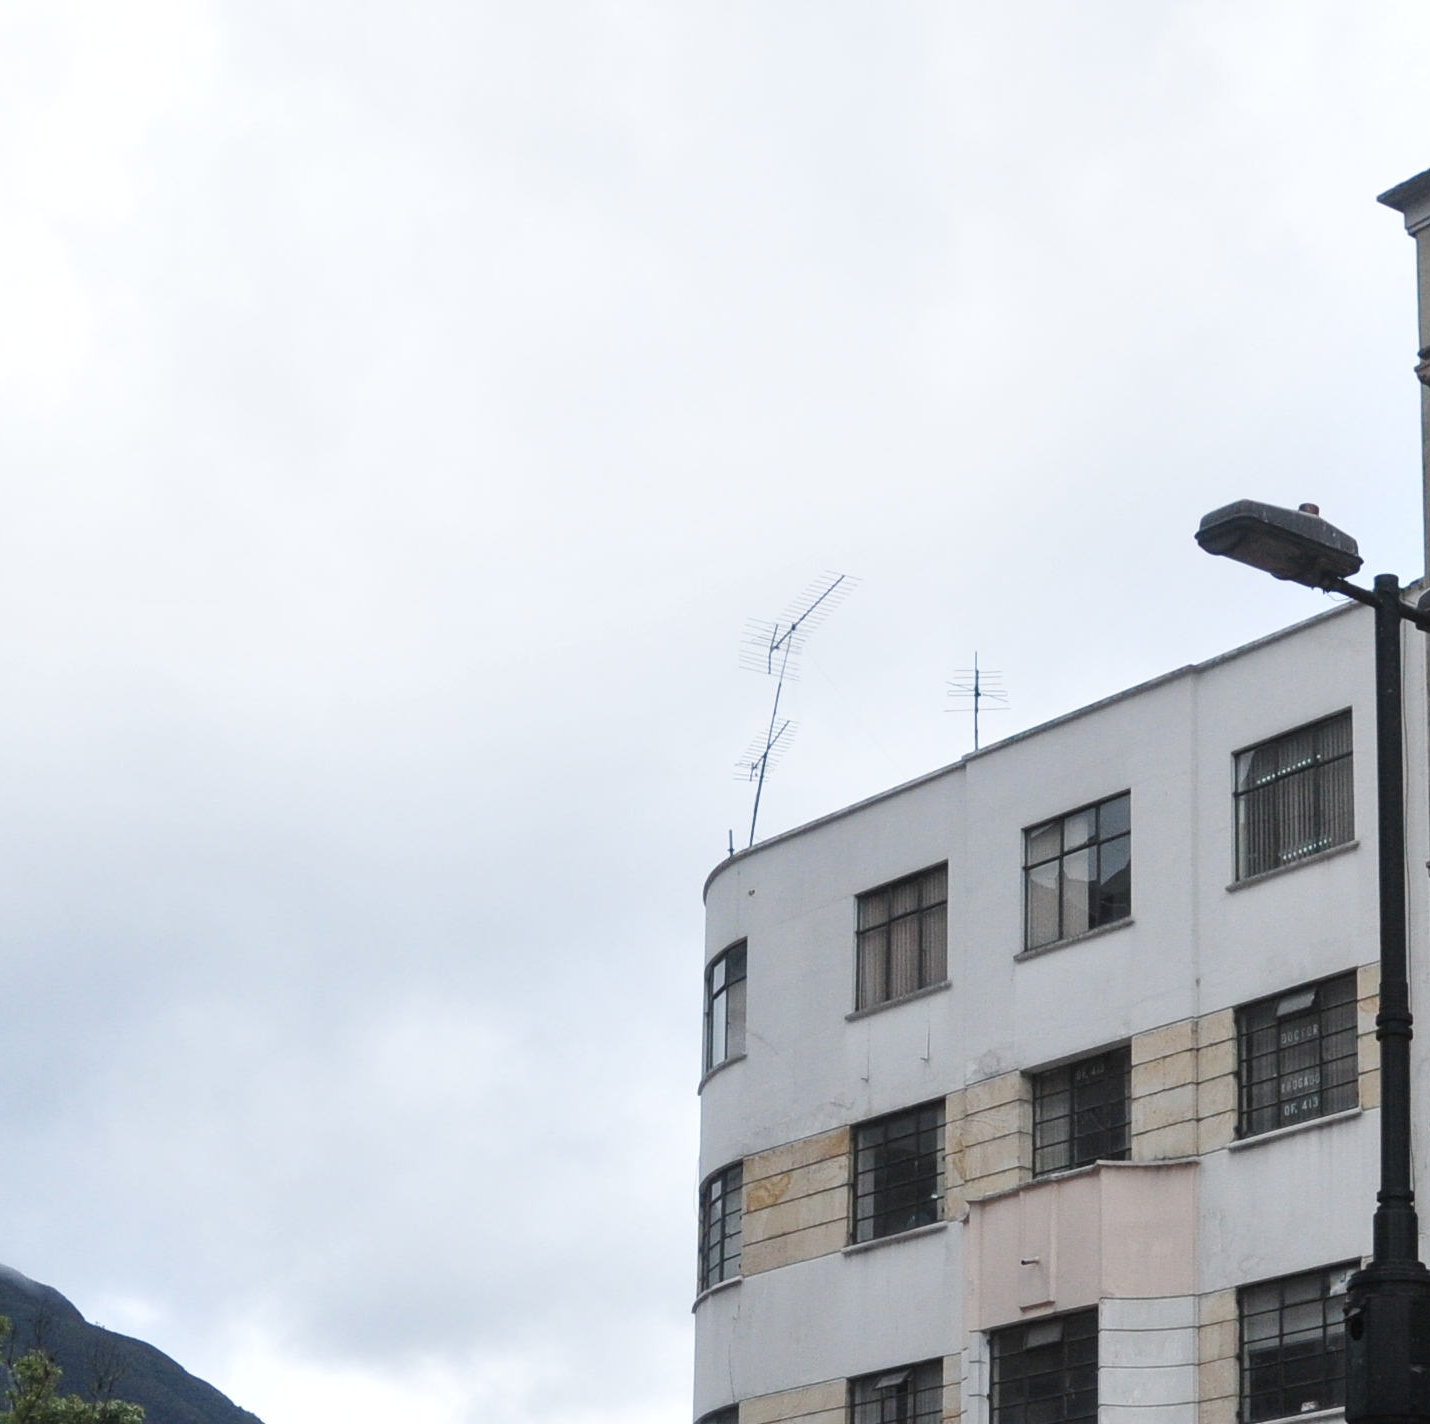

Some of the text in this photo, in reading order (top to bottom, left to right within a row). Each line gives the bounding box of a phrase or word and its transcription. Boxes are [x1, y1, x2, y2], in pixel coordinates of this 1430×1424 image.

[1281, 1023, 1319, 1044] DOCTOR
[1281, 1074, 1321, 1094] ABOGADO
[1301, 1096, 1319, 1110] 413
